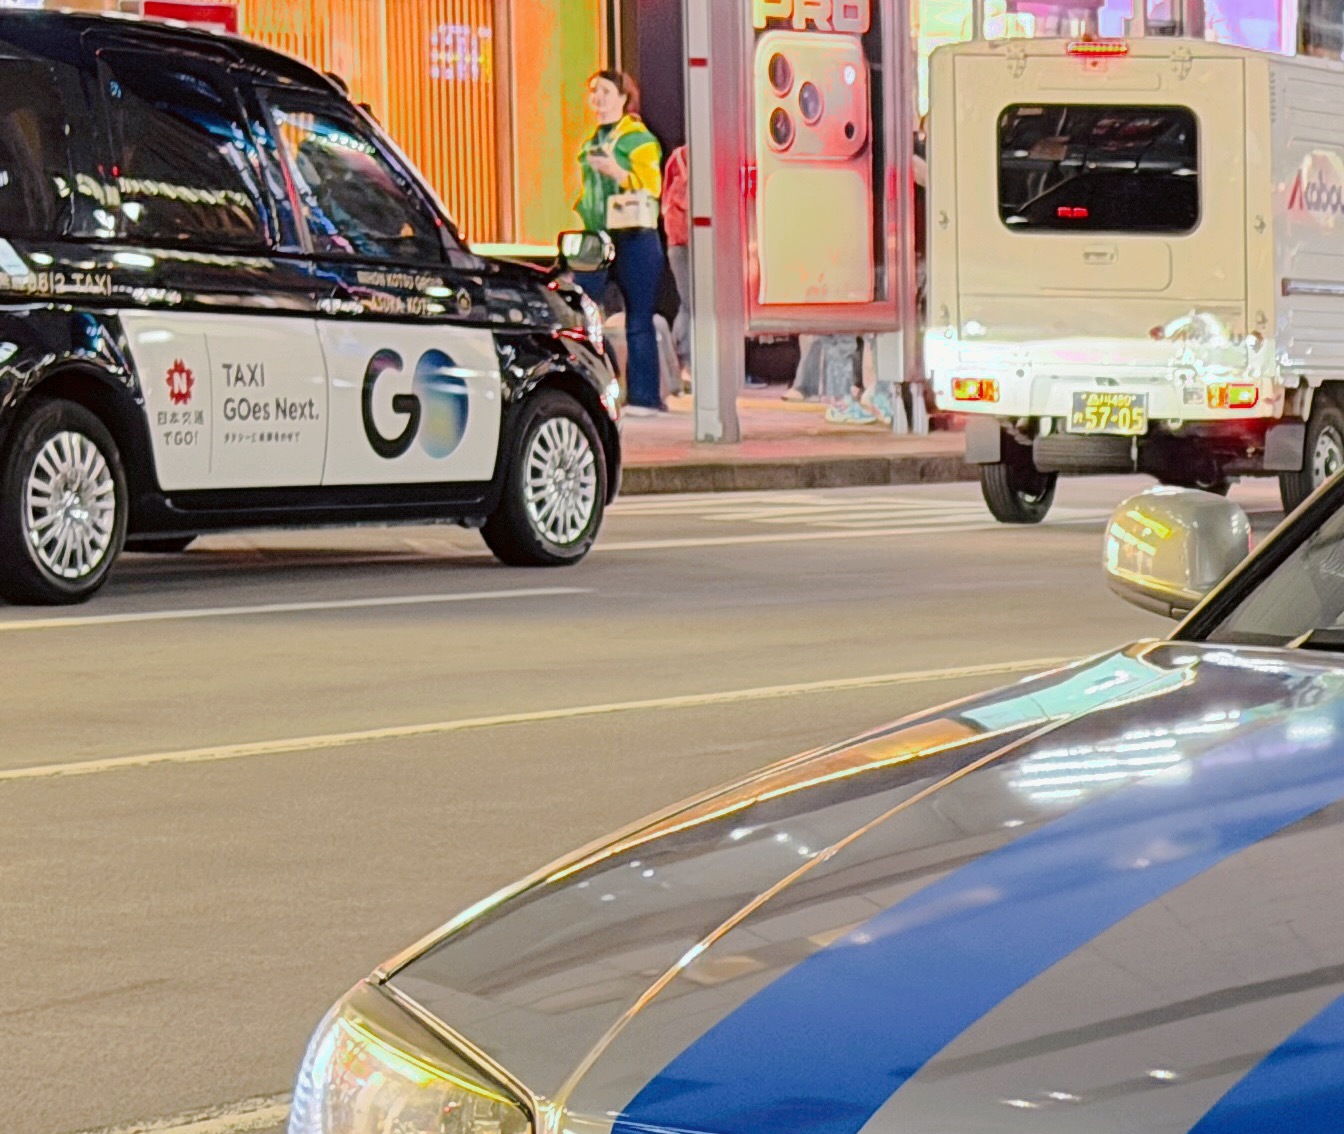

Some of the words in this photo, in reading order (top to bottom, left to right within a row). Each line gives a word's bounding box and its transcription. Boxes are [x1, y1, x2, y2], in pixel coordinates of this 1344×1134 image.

[753, 0, 870, 32] PRO
[222, 363, 265, 388] TAXI
[223, 398, 271, 421] GOes
[275, 397, 320, 421] Next.
[361, 349, 469, 459] GO
